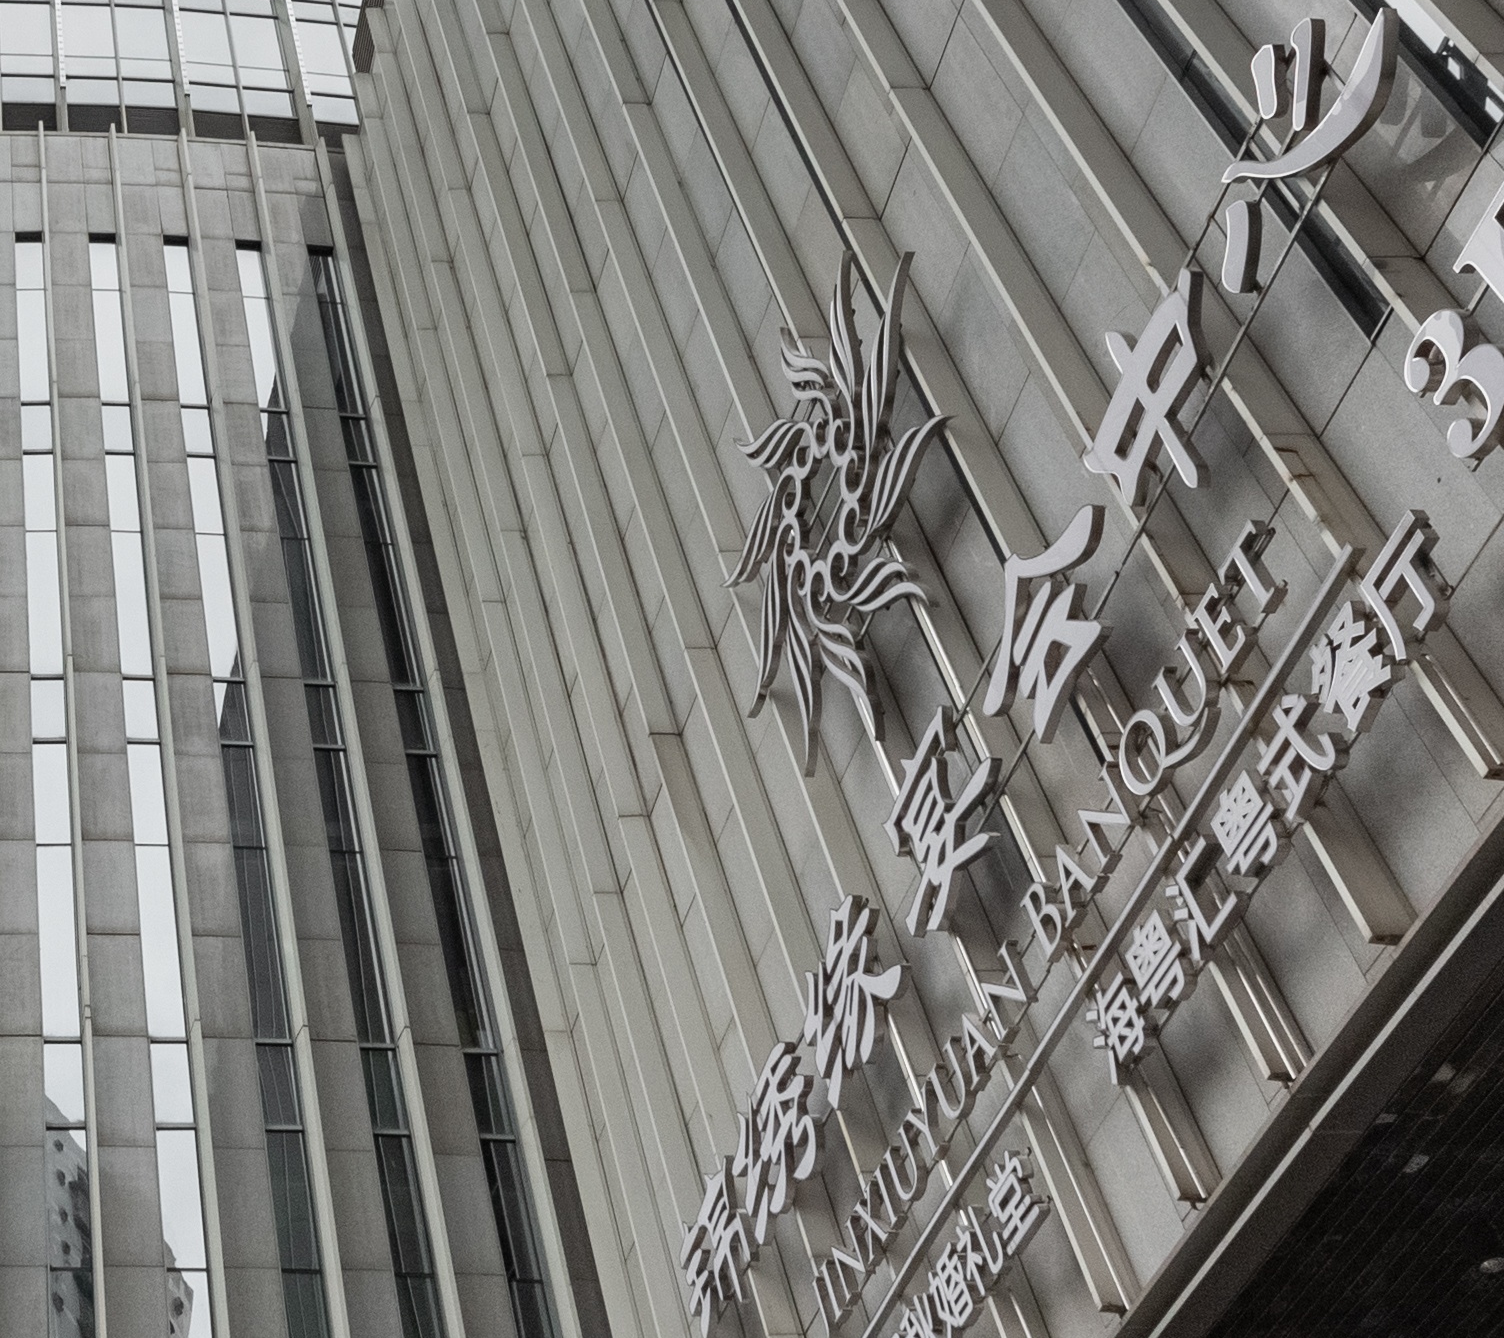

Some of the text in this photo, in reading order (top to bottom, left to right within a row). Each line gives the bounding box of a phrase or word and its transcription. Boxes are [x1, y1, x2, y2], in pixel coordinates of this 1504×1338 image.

[1020, 519, 1288, 964] BANQUET
[1085, 509, 1454, 1086] 海粤汇粤式餐厅
